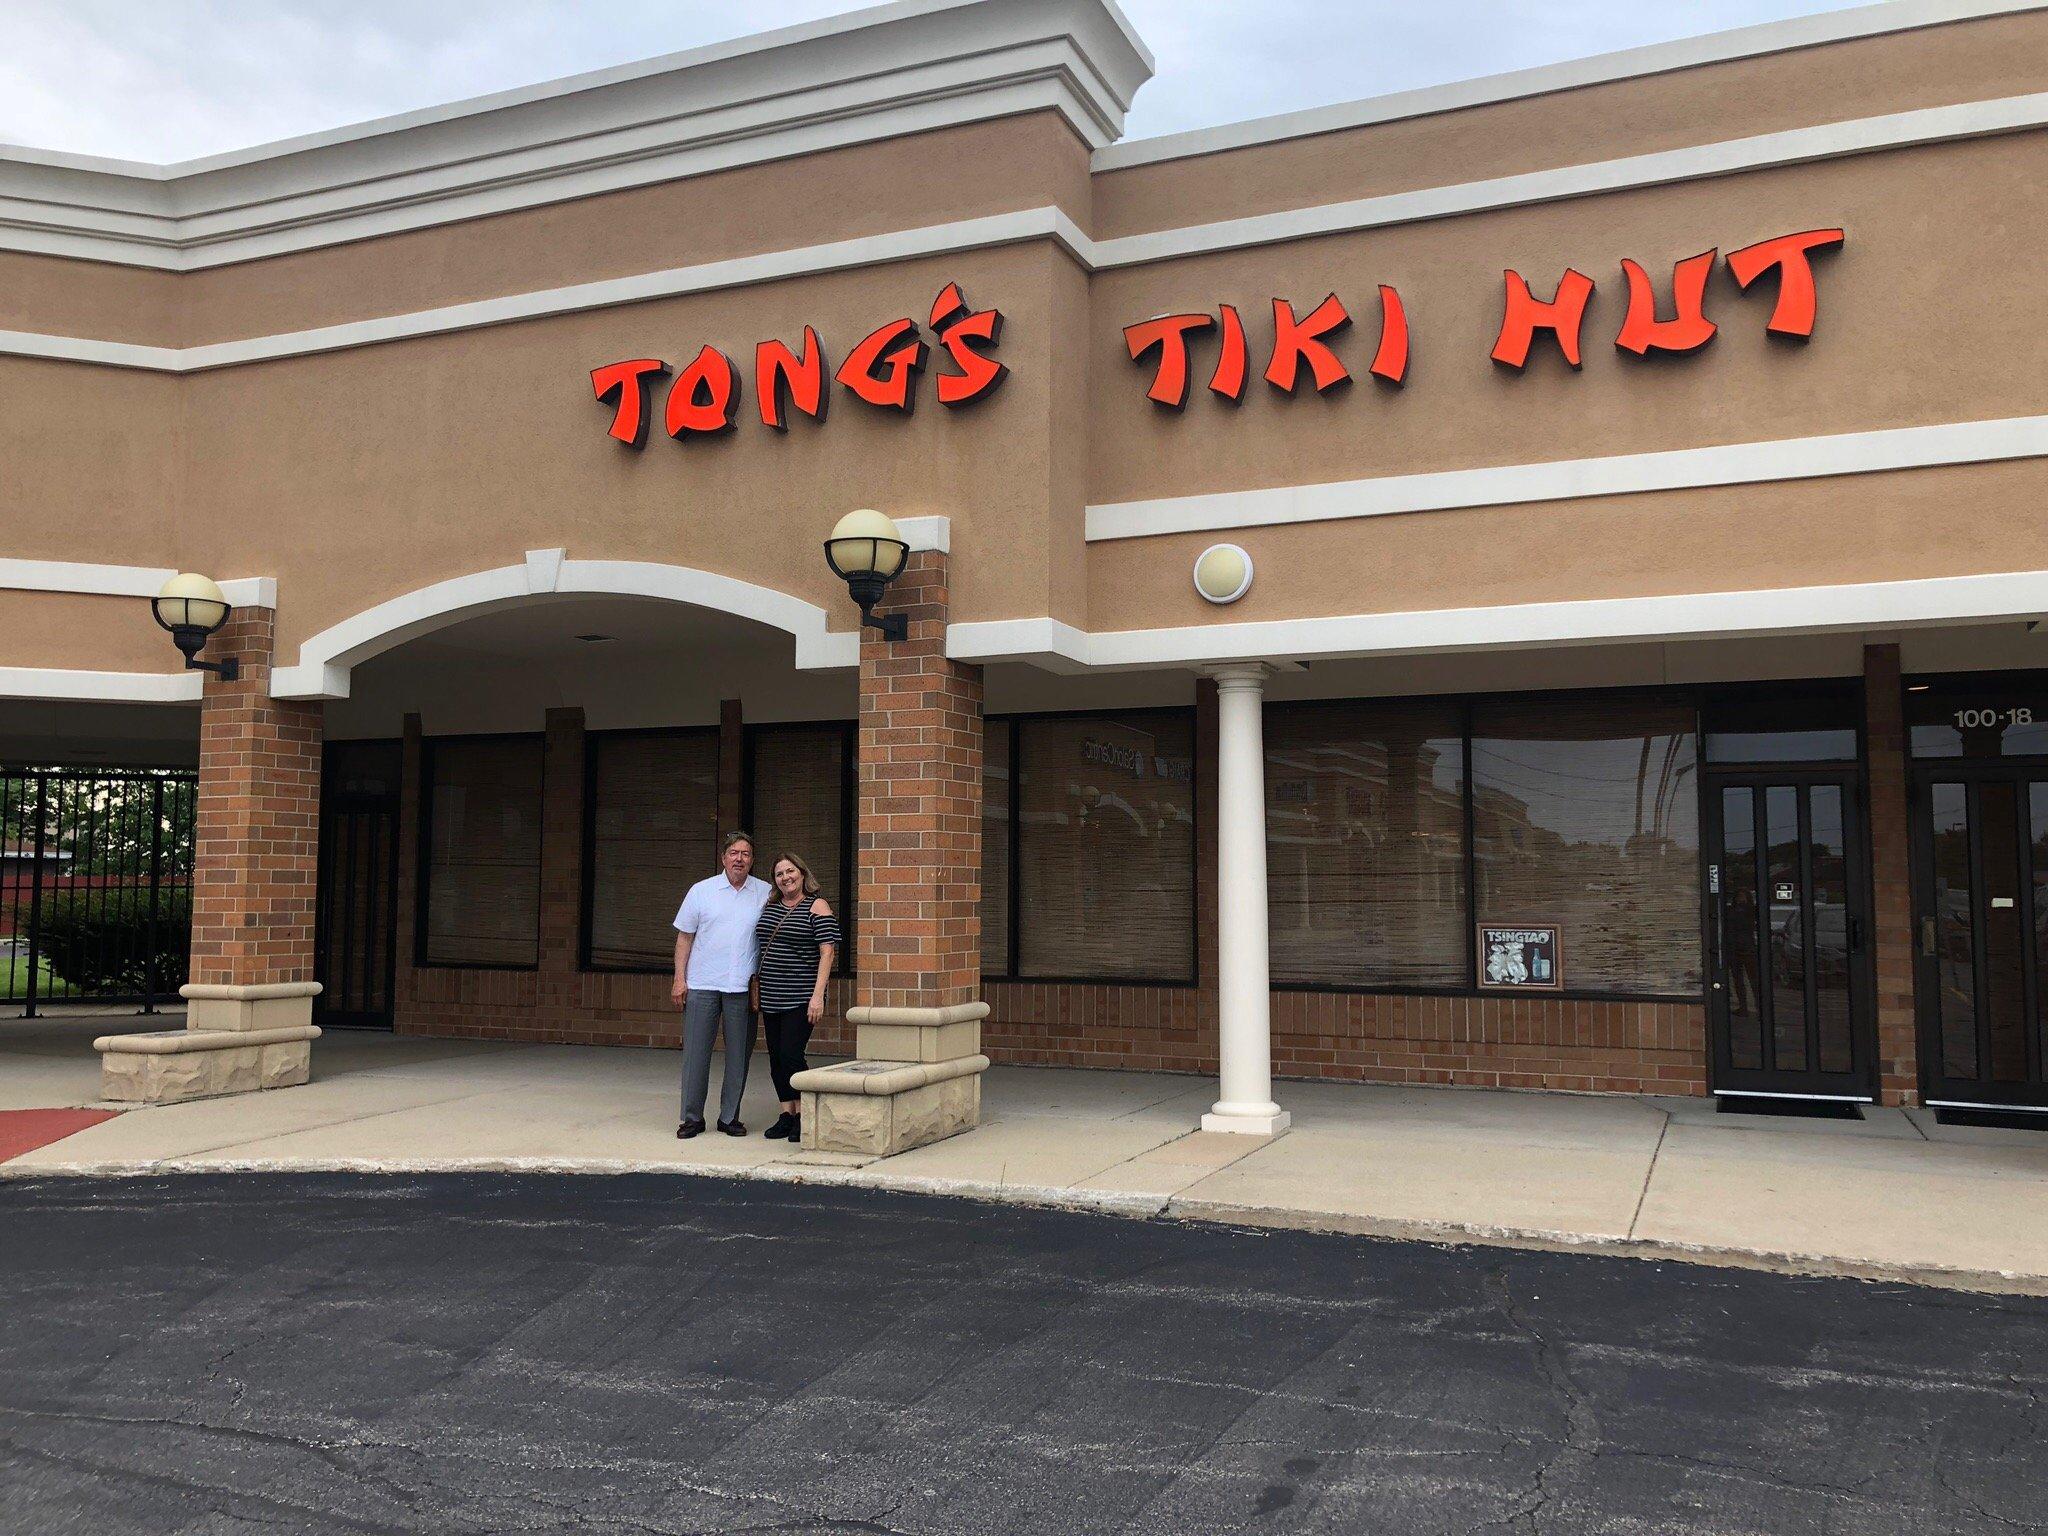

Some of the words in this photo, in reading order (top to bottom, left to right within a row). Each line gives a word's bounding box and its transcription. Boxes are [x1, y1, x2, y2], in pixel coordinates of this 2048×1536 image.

[590, 281, 1008, 448] TONG'S
[1123, 284, 1410, 411] TIKI
[1491, 228, 1844, 369] HUT
[1487, 931, 1550, 944] TSINGTAO
